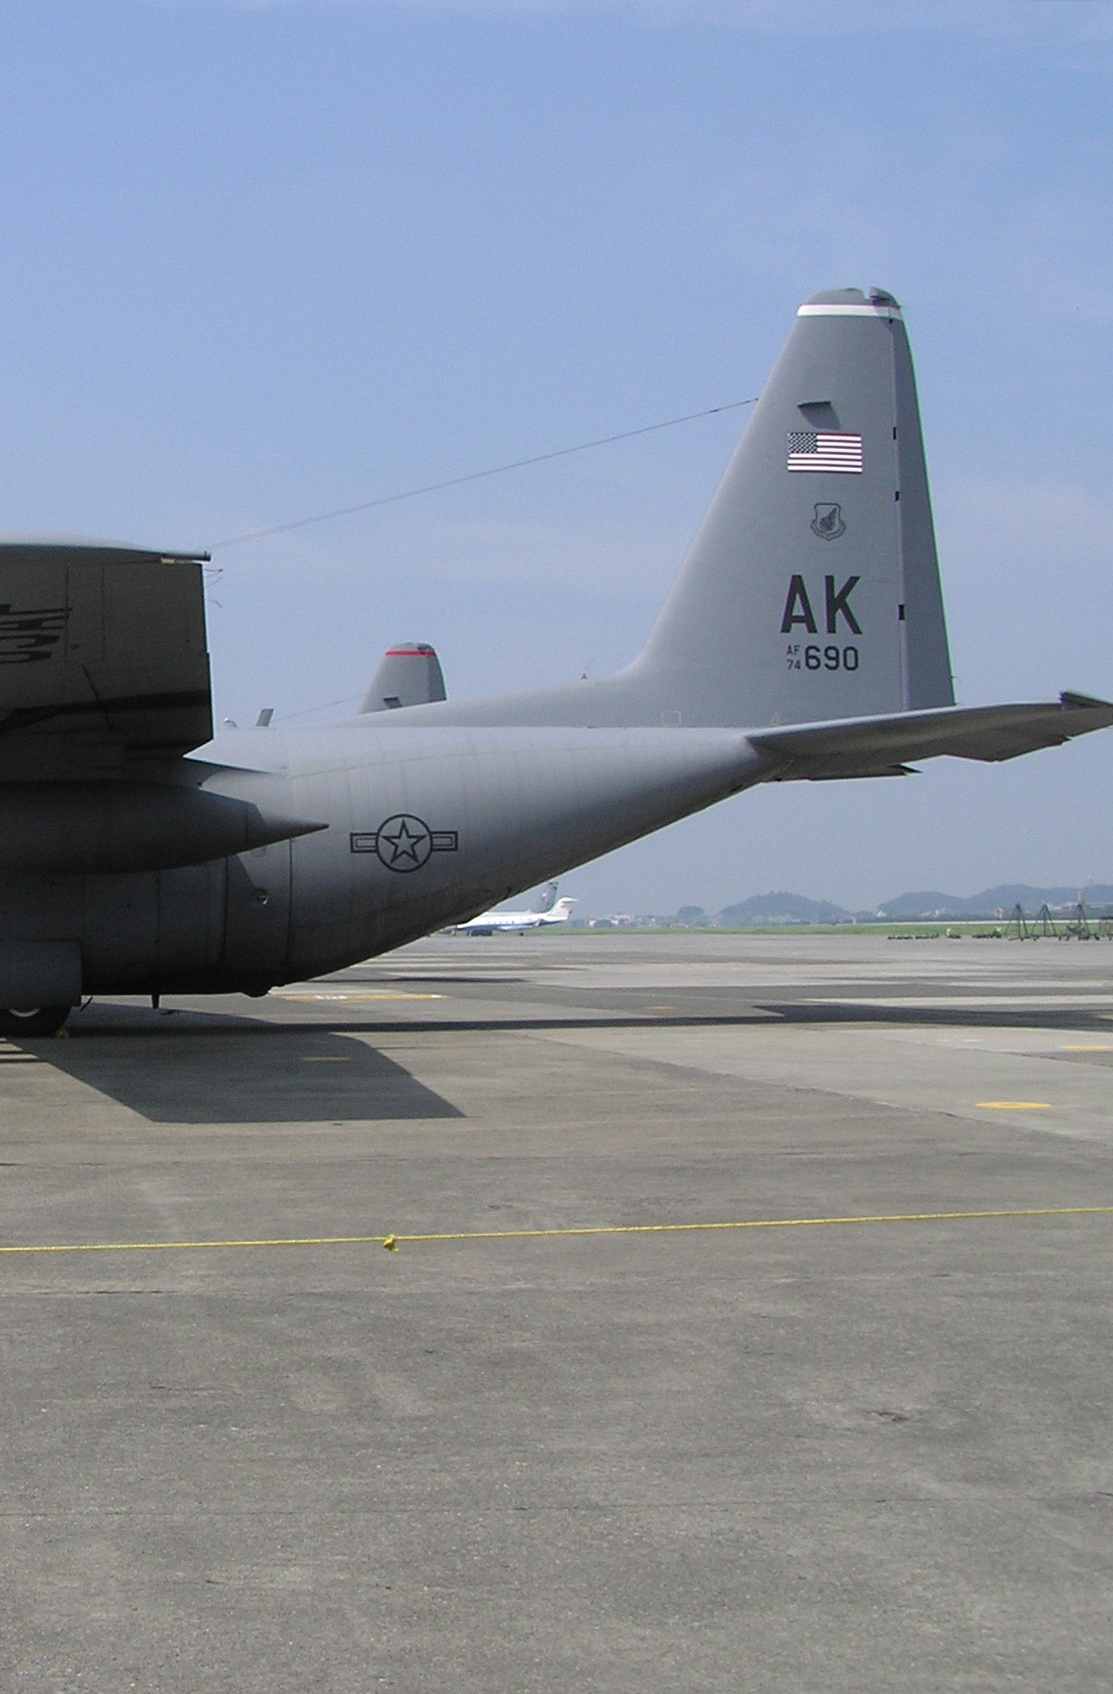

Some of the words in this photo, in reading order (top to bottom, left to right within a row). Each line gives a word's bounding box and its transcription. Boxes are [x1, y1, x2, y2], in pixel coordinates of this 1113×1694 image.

[780, 574, 863, 635] AK
[786, 644, 801, 656] AF
[805, 645, 859, 671] 690
[786, 659, 802, 671] 74
